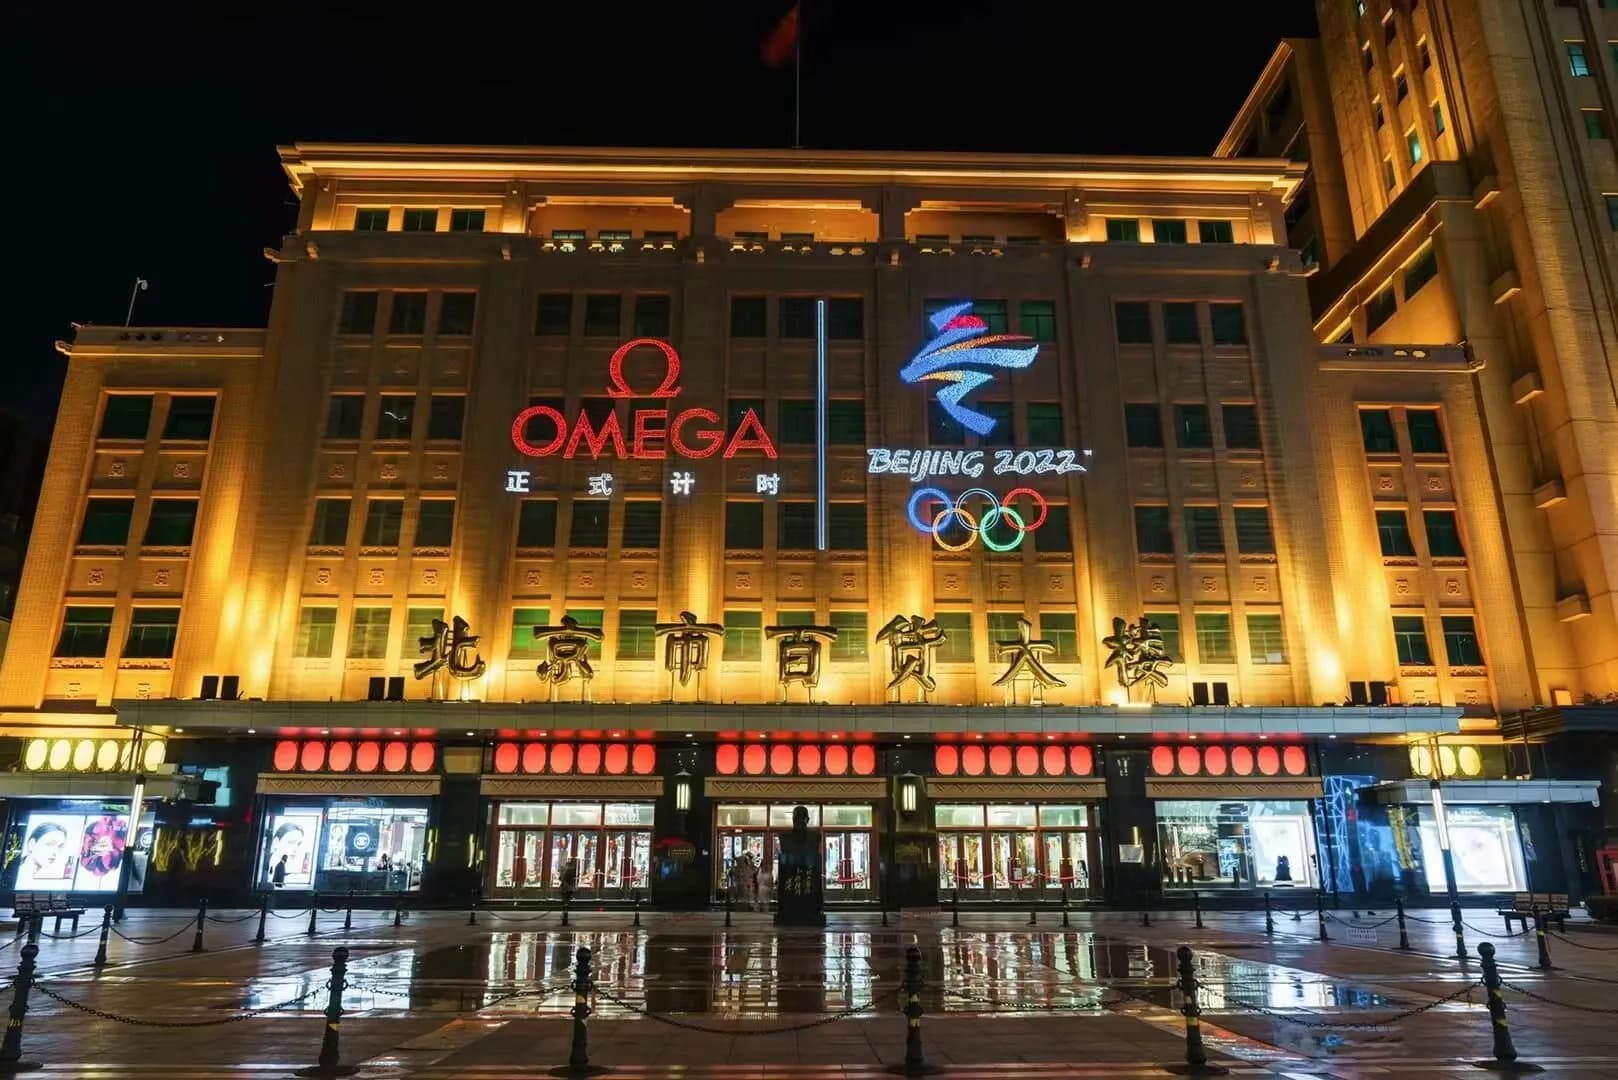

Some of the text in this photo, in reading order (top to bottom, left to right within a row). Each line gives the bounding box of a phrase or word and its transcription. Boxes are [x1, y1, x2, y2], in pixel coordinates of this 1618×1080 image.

[511, 405, 778, 459] OMEGA
[505, 471, 780, 495] 正式计时
[867, 448, 1087, 482] BEIJING 2022
[413, 611, 1174, 692] 北京市百货大楼
